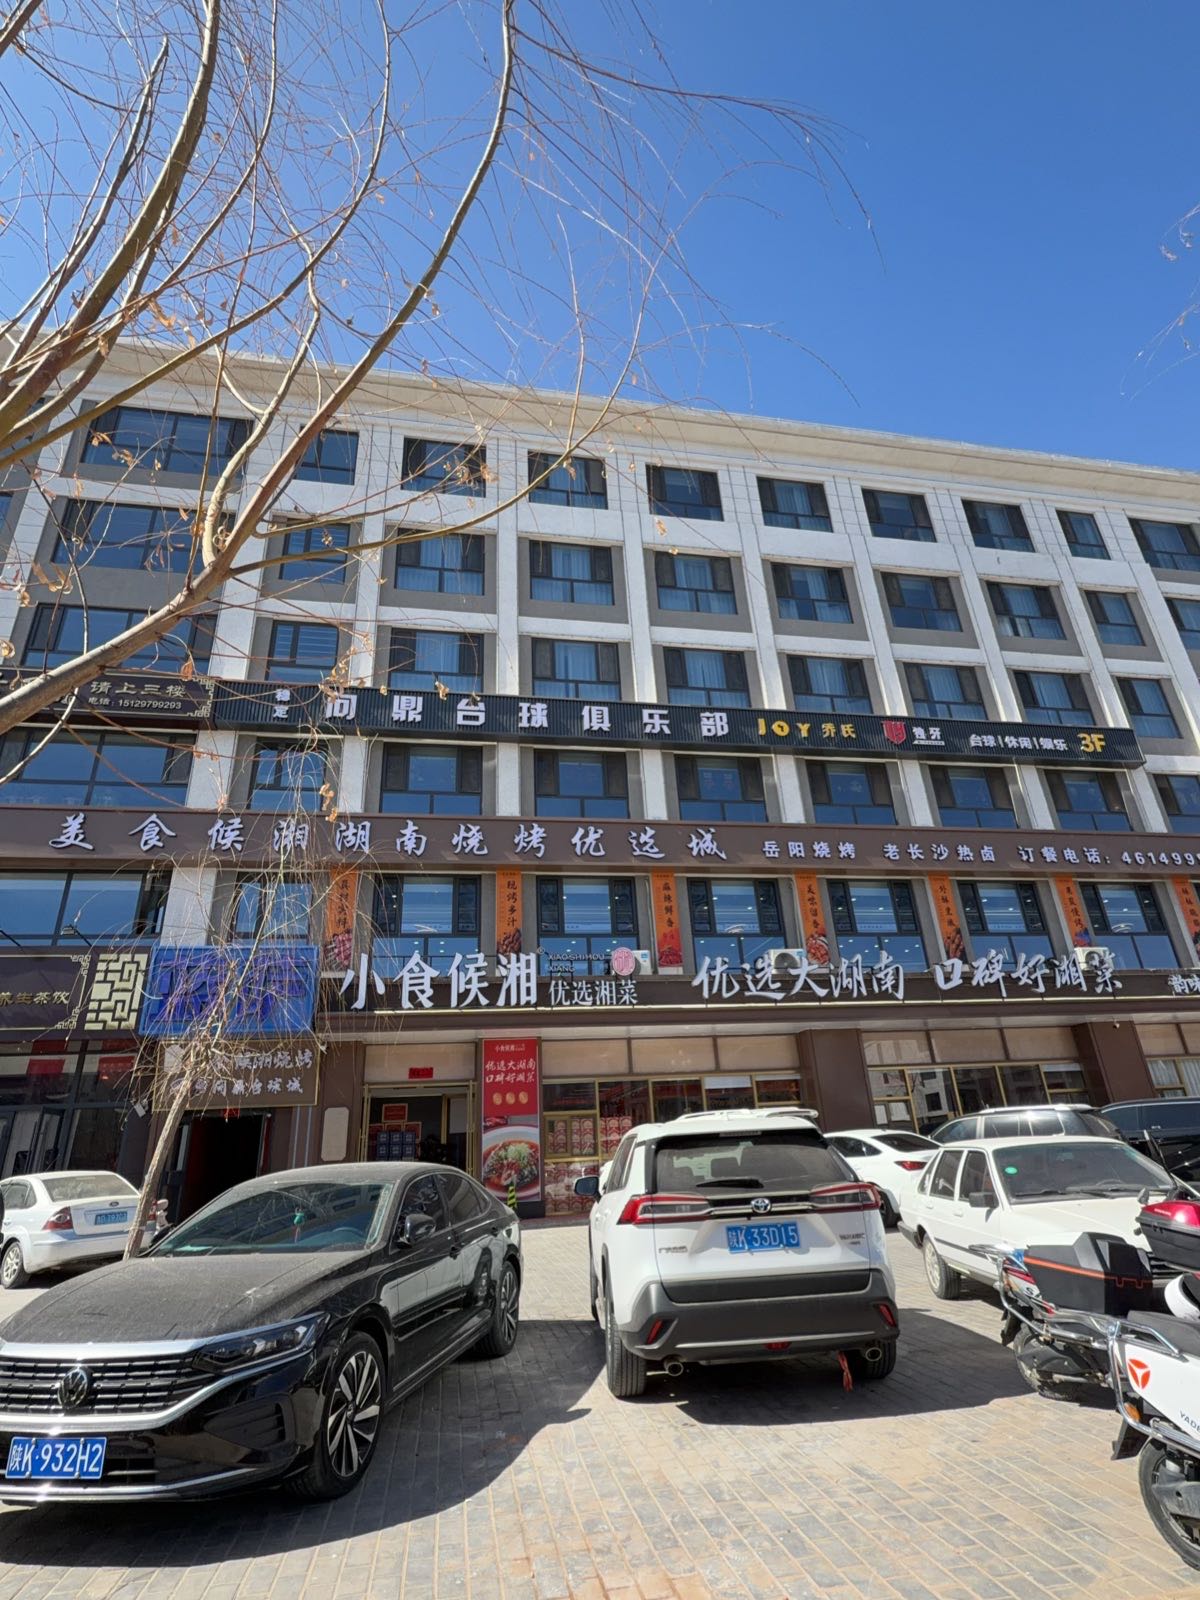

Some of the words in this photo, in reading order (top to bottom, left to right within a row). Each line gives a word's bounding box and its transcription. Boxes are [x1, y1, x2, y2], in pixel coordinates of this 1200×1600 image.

[90, 681, 186, 697] 请上三楼
[325, 693, 729, 738] 问鼎台球俱乐部
[757, 718, 811, 738] JOY
[822, 723, 856, 738] 乔氏
[1077, 733, 1106, 753] 3F
[762, 841, 857, 861] 岳阳烧烤
[883, 843, 996, 863] 老长沙热卤
[506, 880, 518, 928] 现烤多汁
[339, 951, 538, 1010] 小食候湘
[691, 950, 905, 1001] 优选大湖南
[935, 948, 1123, 998] 口碑好湘菜
[548, 979, 639, 1006] 优选湘菜
[485, 1058, 536, 1072] 优选大湖南
